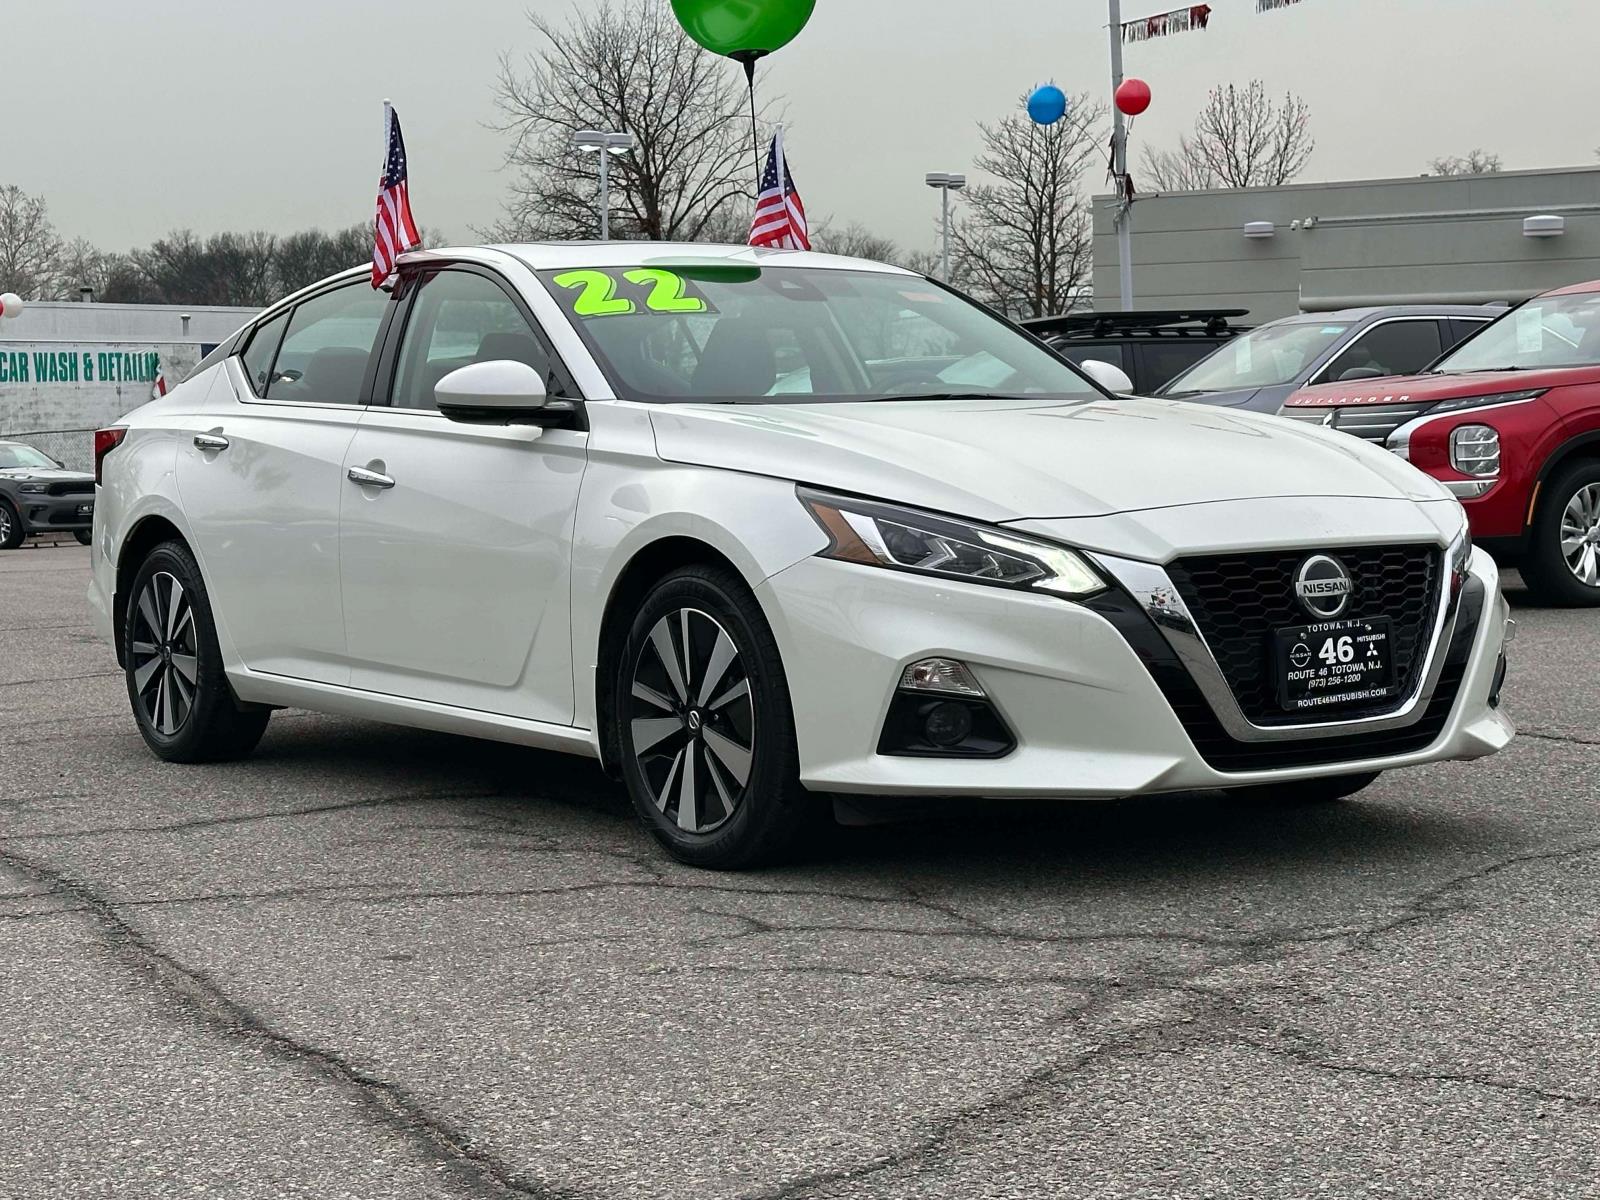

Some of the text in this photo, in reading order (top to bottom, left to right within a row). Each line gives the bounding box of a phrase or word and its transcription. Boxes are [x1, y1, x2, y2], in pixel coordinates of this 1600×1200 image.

[553, 269, 706, 317] 22
[0, 352, 29, 382] CAR
[33, 352, 79, 382] WASH
[83, 352, 94, 382] &
[1303, 581, 1347, 593] NISSAN
[1308, 619, 1364, 632] TOTOWA, N.J.
[1356, 633, 1386, 642] MITSUBISHI
[1318, 635, 1354, 665] 46
[1288, 660, 1383, 680] ROUTE 46 TOTOWA, N.J.
[1308, 674, 1361, 689] (973) 256-1200
[1298, 688, 1387, 707] ROUTE46MITSUBISHI.COM
